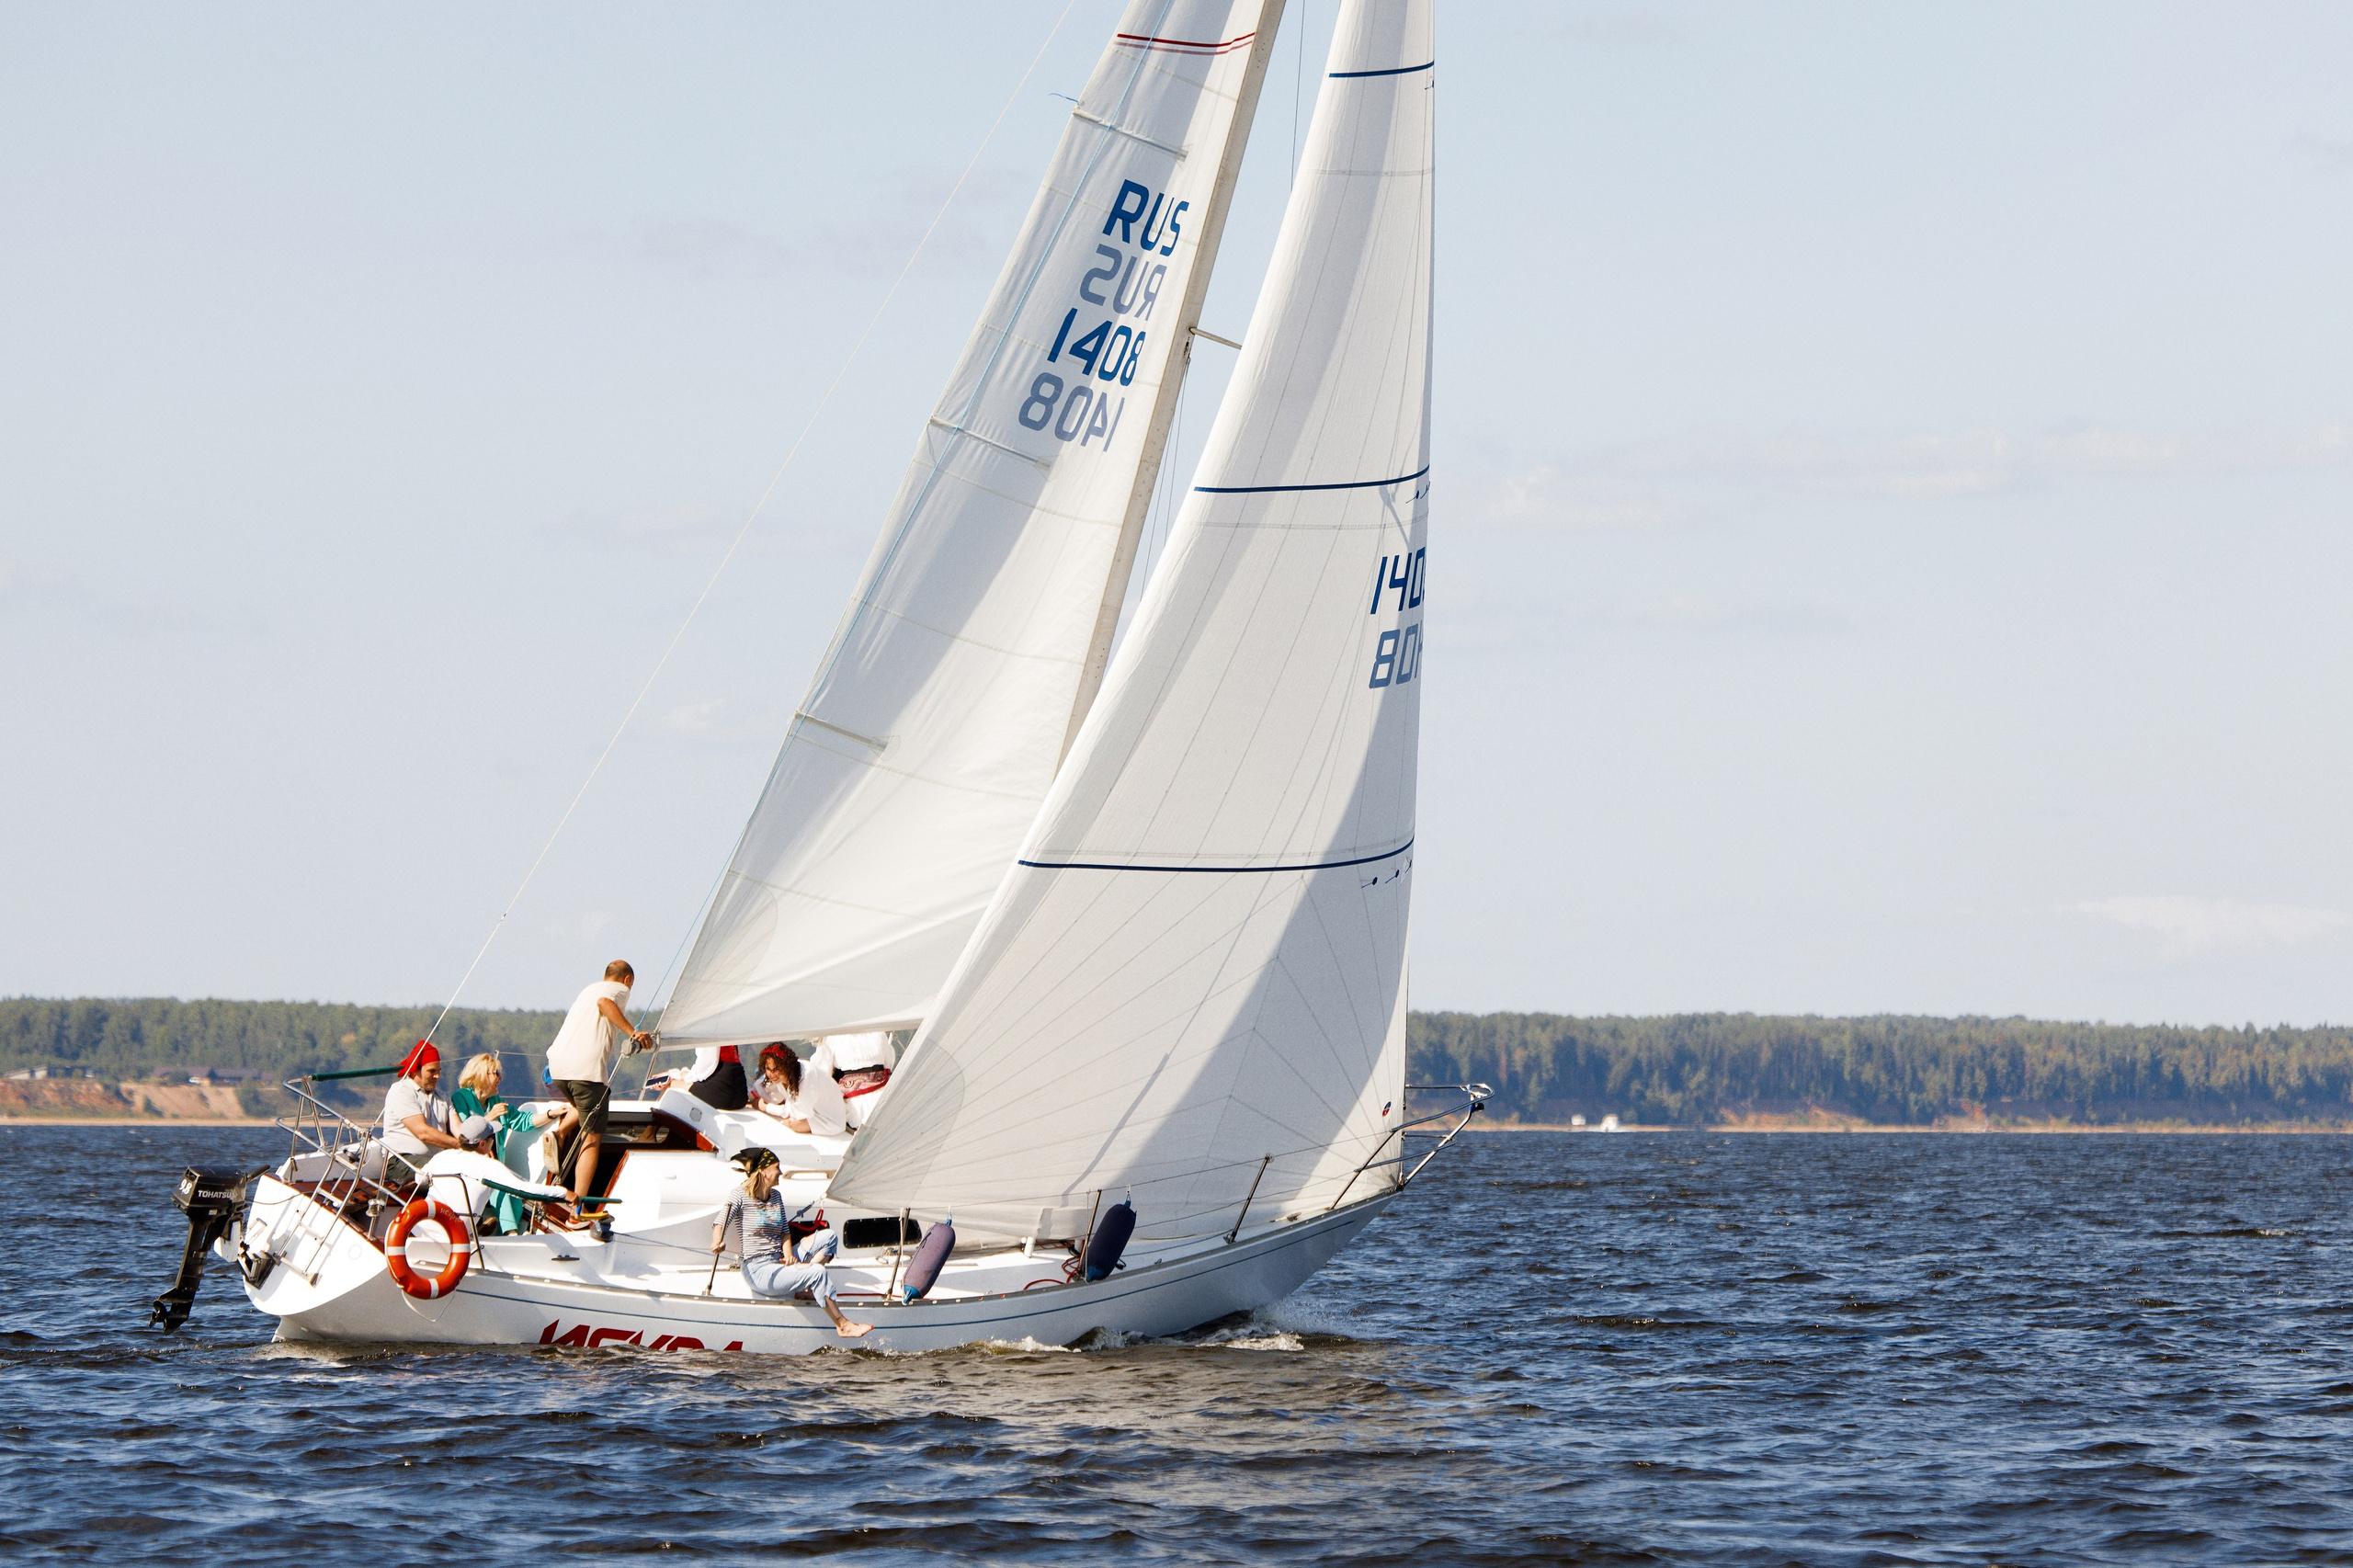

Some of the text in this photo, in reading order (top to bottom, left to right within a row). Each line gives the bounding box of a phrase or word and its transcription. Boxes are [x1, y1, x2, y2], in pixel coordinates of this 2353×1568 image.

[1102, 178, 1189, 257] RUS
[1047, 307, 1147, 387] 1408
[1370, 546, 1426, 615] 140
[198, 1190, 232, 1199] TOHATSU
